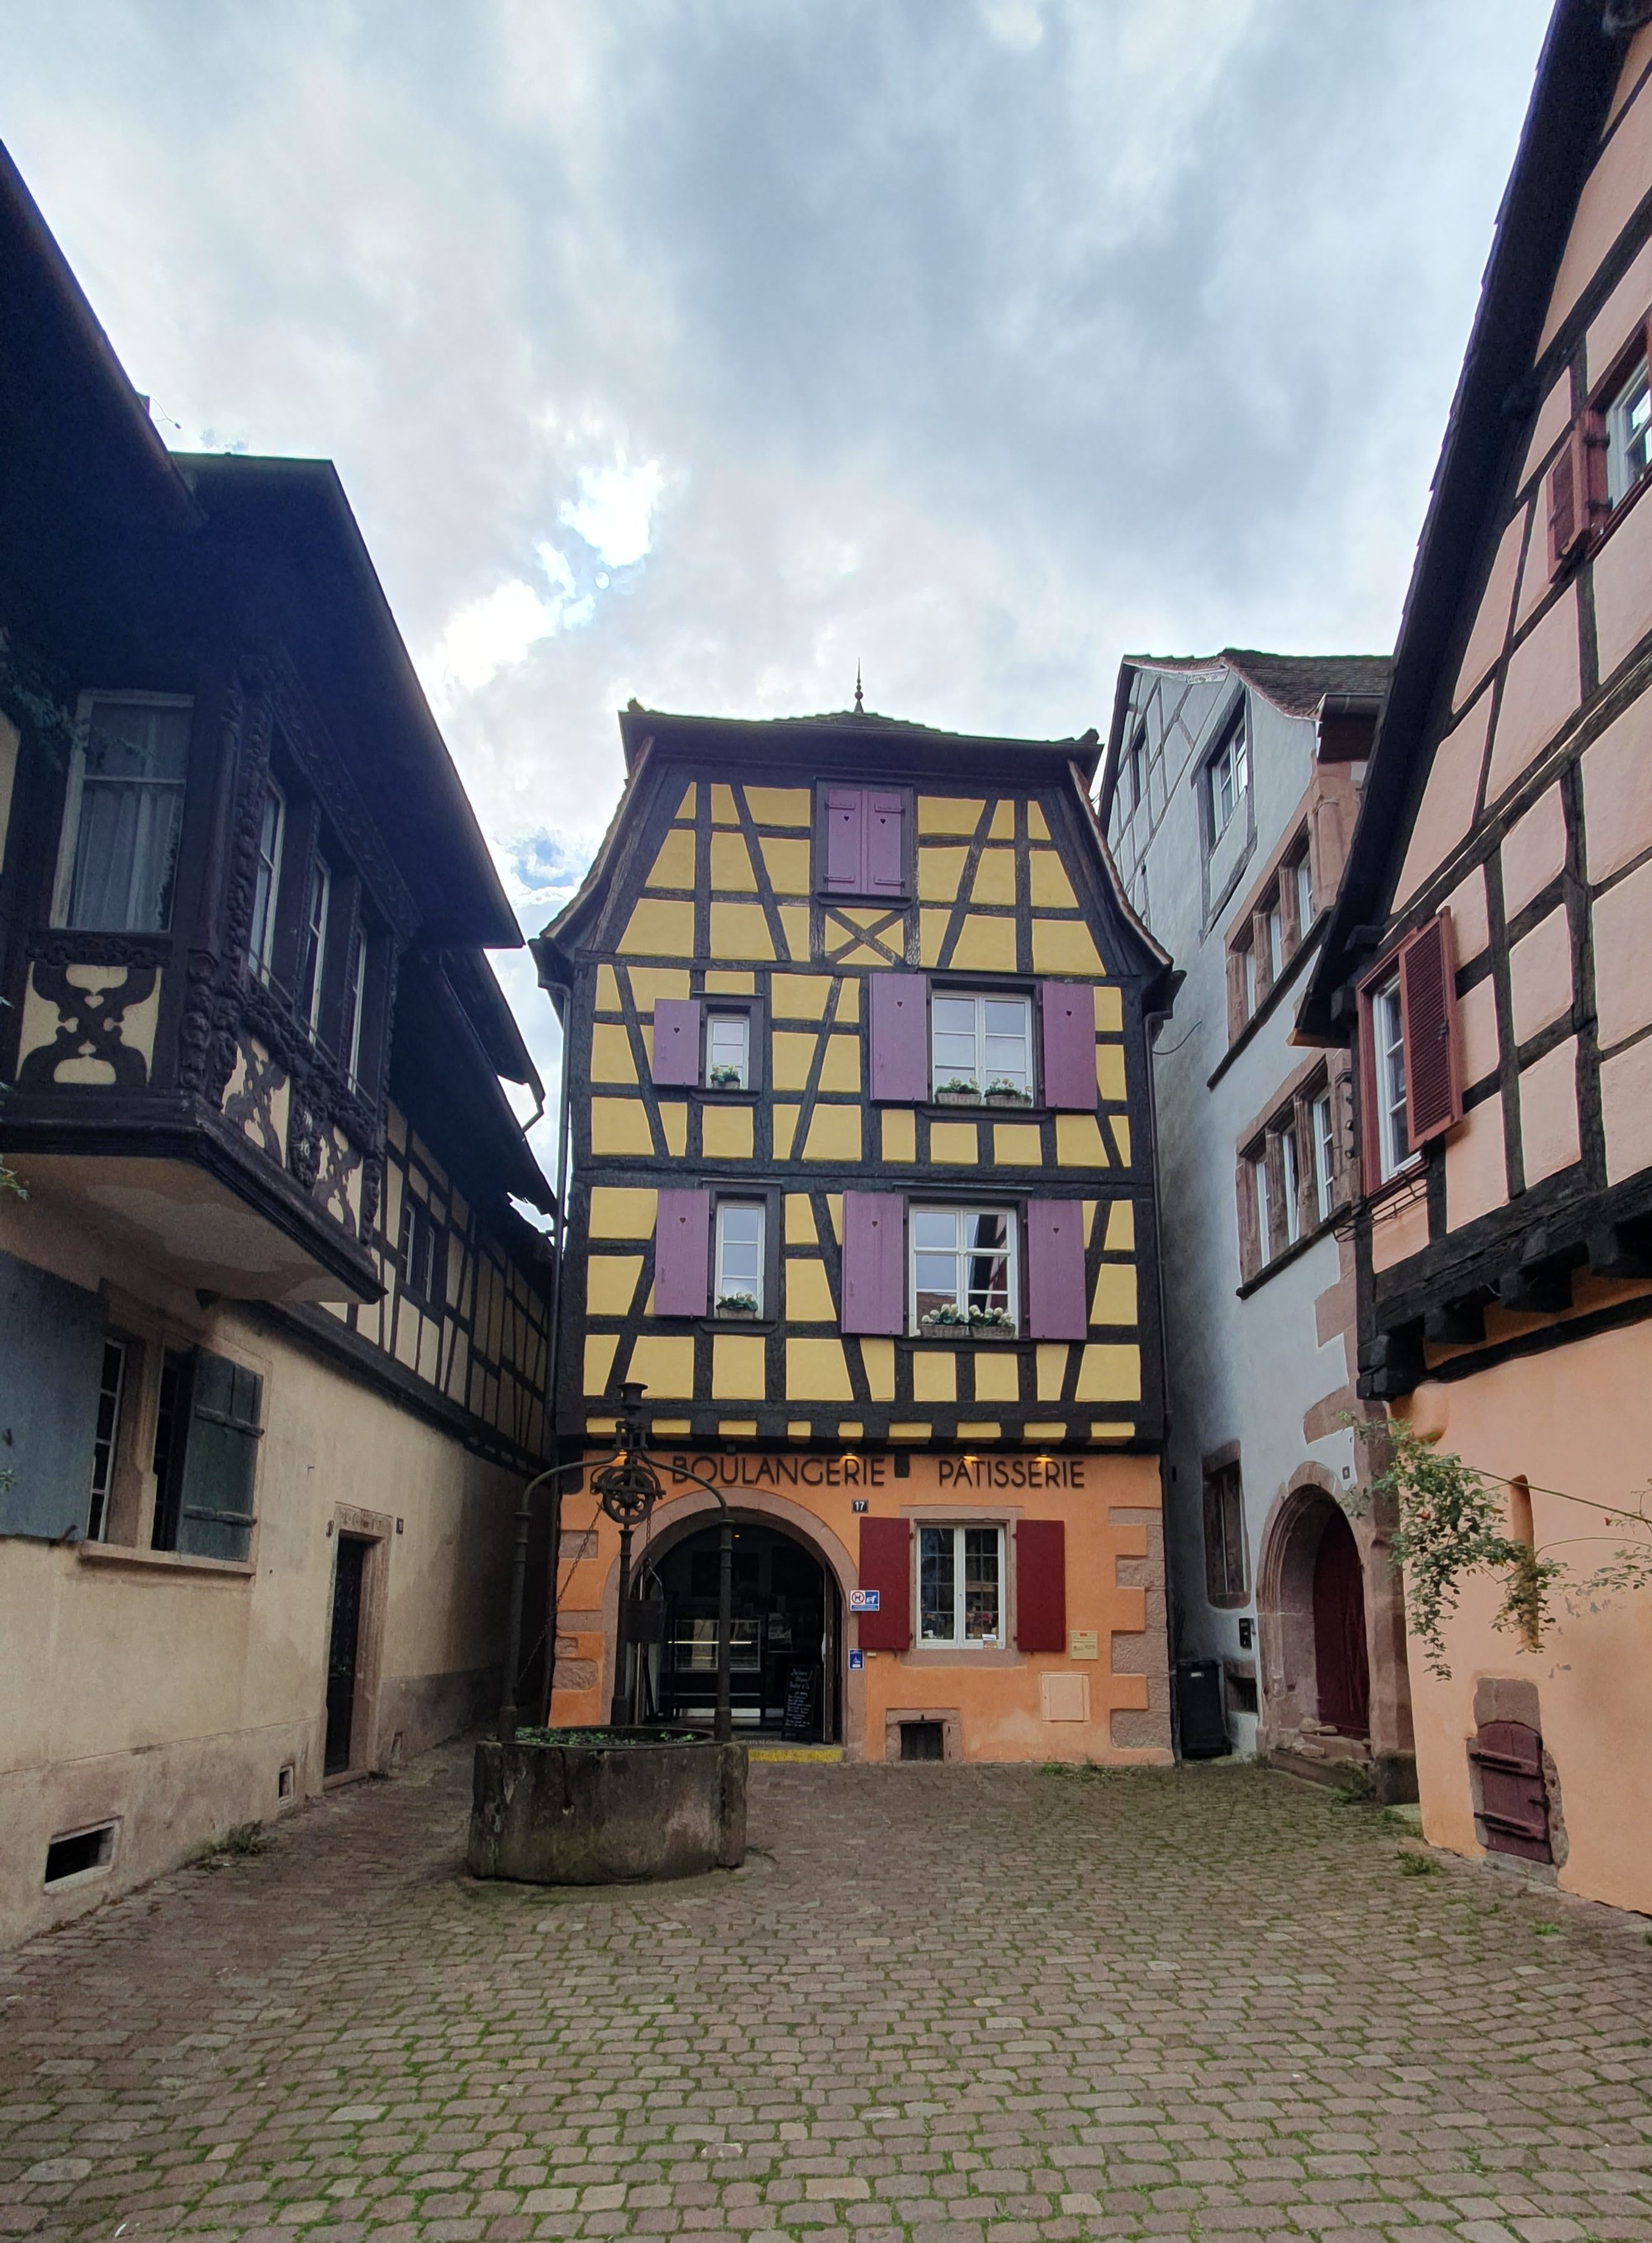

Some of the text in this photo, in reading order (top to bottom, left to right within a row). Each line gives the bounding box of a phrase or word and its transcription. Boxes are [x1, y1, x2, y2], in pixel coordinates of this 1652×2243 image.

[672, 1456, 1085, 1488] BOULANGERIE PÂTISSERIE
[854, 1500, 865, 1511] 17
